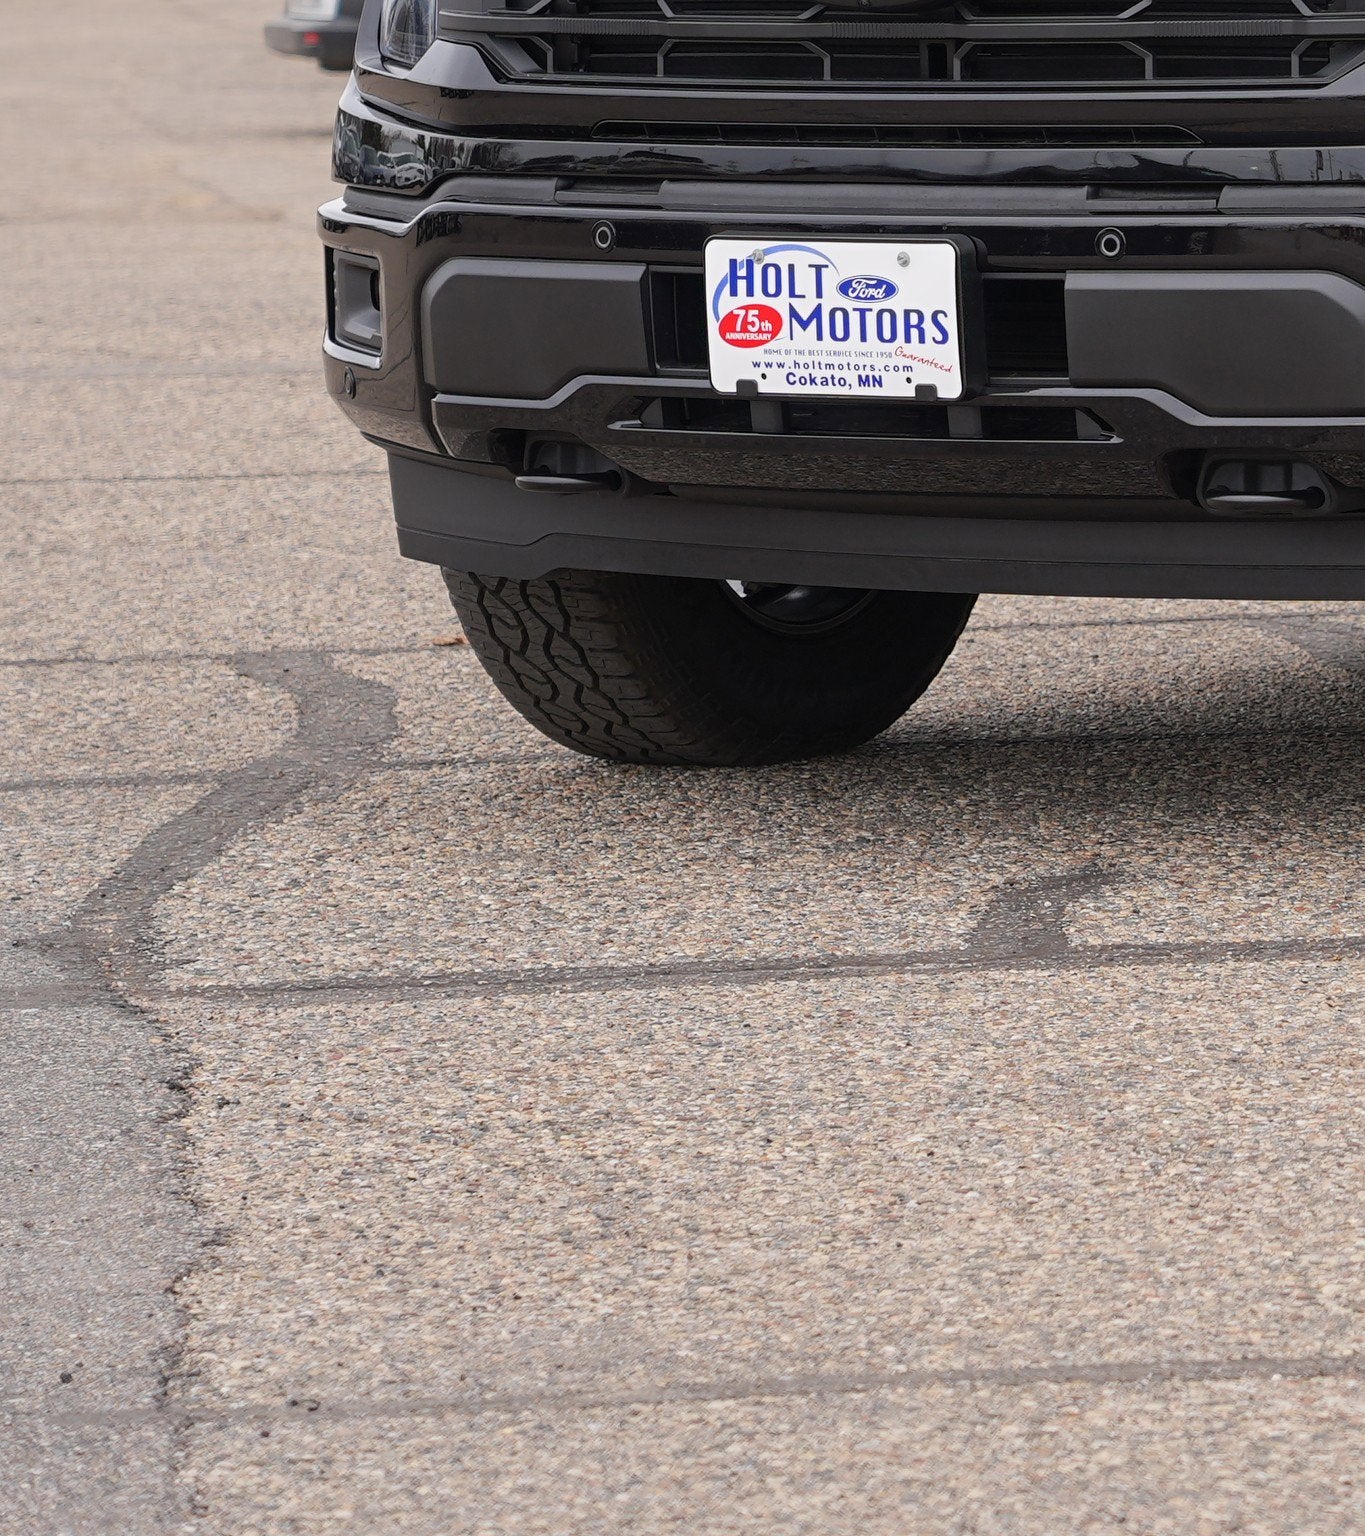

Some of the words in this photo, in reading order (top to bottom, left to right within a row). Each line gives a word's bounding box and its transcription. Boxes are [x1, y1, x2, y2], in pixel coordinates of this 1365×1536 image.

[728, 258, 829, 300] HOLT
[848, 278, 888, 300] Ford
[732, 309, 773, 332] 75th
[788, 302, 950, 346] MOTORS
[725, 332, 772, 342] ANNIVERSARY
[751, 359, 914, 373] www.holtmotors.com
[808, 349, 823, 357] BEST
[825, 350, 852, 358] SERVICE
[854, 350, 874, 358] SINCE
[876, 351, 893, 359] 1950
[894, 345, 953, 373] Guaranteed
[785, 372, 853, 390] Cokato,
[857, 373, 884, 389] MN
